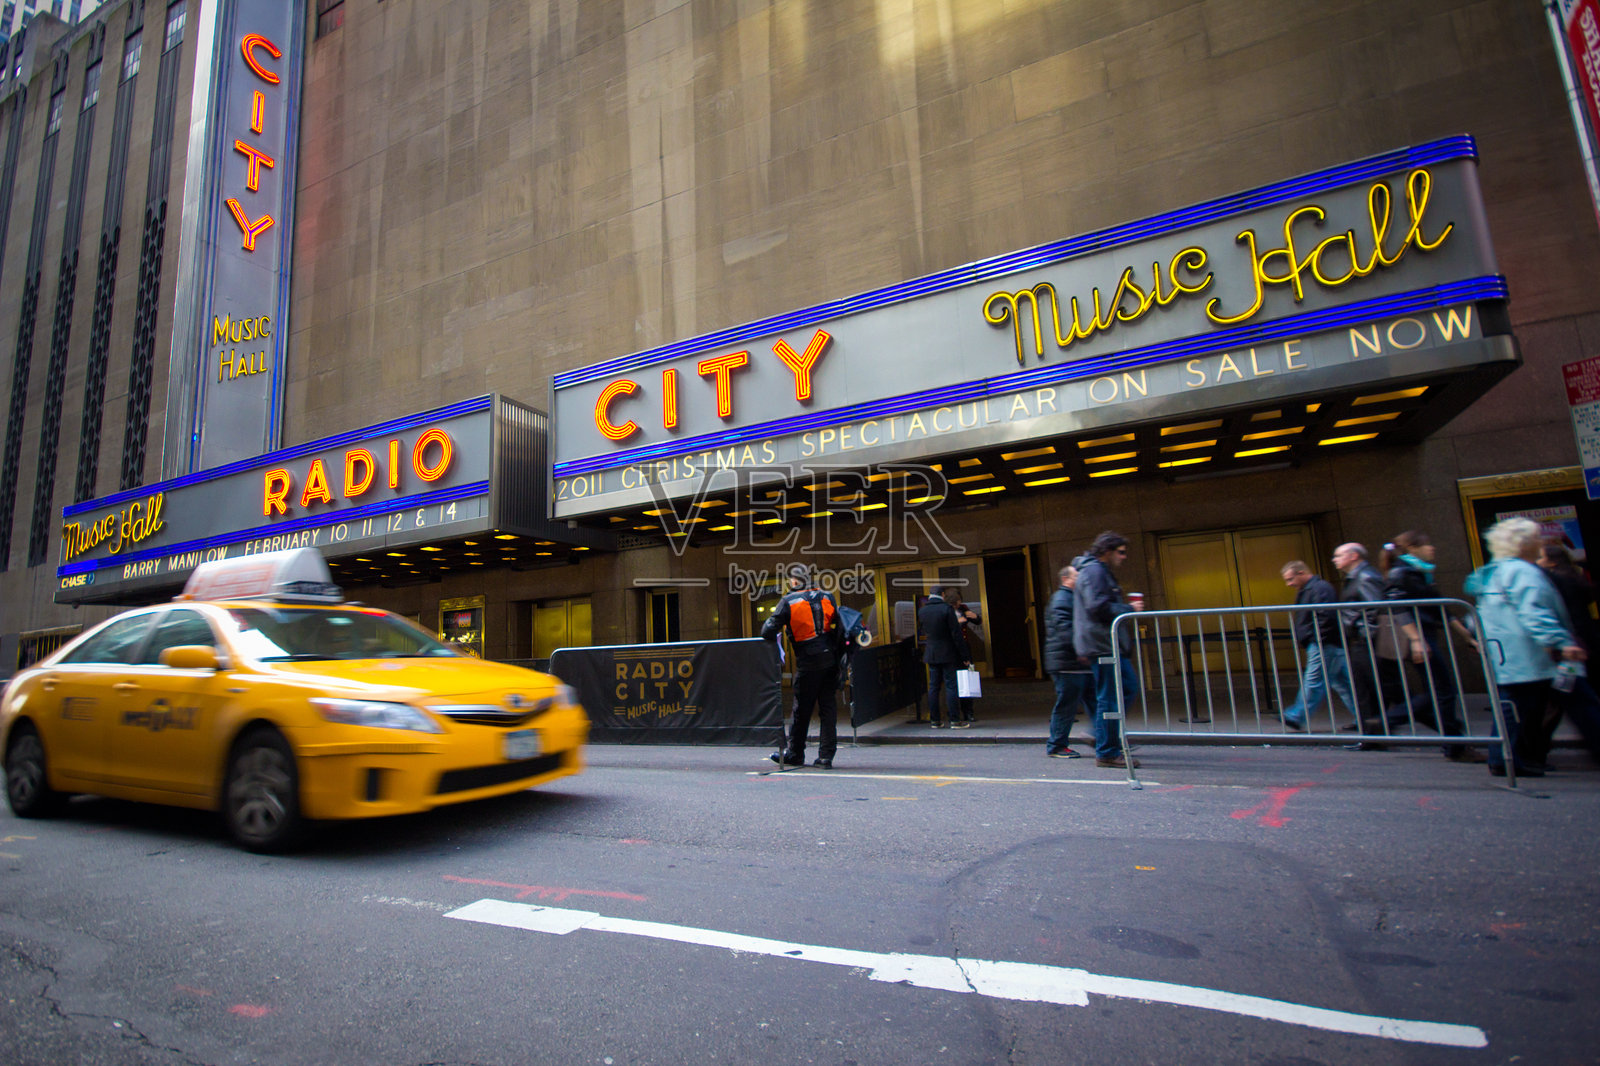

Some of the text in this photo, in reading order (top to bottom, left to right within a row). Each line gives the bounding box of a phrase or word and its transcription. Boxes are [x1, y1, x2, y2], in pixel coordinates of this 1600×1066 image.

[225, 33, 281, 251] CITY
[983, 168, 1453, 364] Music Hall
[213, 312, 271, 346] MUSIC
[218, 349, 268, 382] HALL
[595, 328, 832, 441] CITY
[558, 306, 1472, 500] 2011 CHRISTMAS SPECTACULAR ON SALE NOW
[263, 428, 453, 516] RADIO
[62, 492, 164, 561] Music Hall
[123, 559, 161, 579] BARRY
[244, 528, 320, 556] FEBRUARY
[387, 513, 403, 532] 12
[415, 508, 425, 527] &
[440, 502, 457, 523] 14
[61, 574, 87, 589] CHASE
[615, 660, 694, 680] RADIO
[615, 681, 694, 701] CITY
[627, 701, 657, 720] MUSIC
[658, 701, 682, 719] HALL
